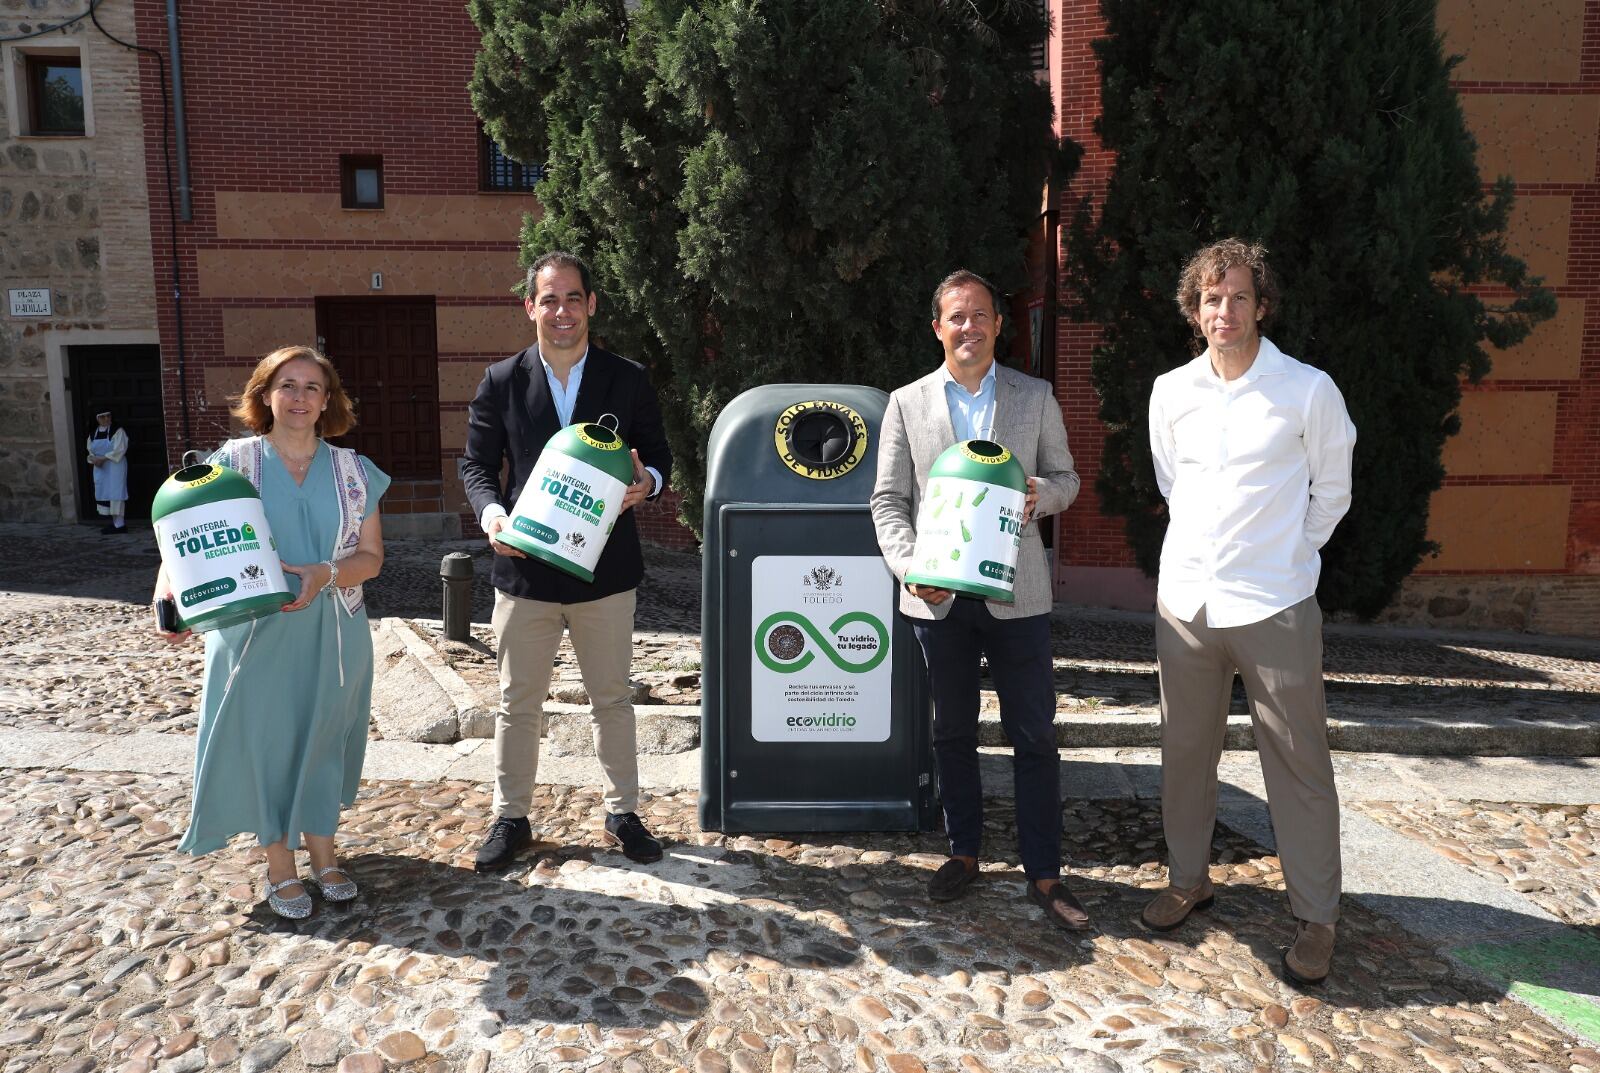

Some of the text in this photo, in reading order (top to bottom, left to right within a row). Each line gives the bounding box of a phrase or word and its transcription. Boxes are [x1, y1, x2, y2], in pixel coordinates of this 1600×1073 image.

[375, 275, 380, 287] 1
[15, 304, 48, 313] PADILLA
[778, 402, 865, 440] SOLO ENVASES
[590, 440, 617, 449] VIDRIO
[783, 453, 858, 477] DE VIDRIO
[981, 454, 1008, 463] VIDRIO
[190, 471, 219, 487] VIDRIO
[560, 473, 592, 494] INTEGRAL
[554, 499, 601, 527] RECICLA VIDRIO
[999, 505, 1015, 518] PLAN
[172, 519, 230, 542] PLAN INTEGRAL
[204, 541, 261, 560] RECICLA VIDRIO
[189, 583, 230, 600] ECOVIDRIO
[850, 634, 877, 643] vidrio,
[848, 643, 878, 651] legado
[786, 712, 857, 727] ecovidrio
